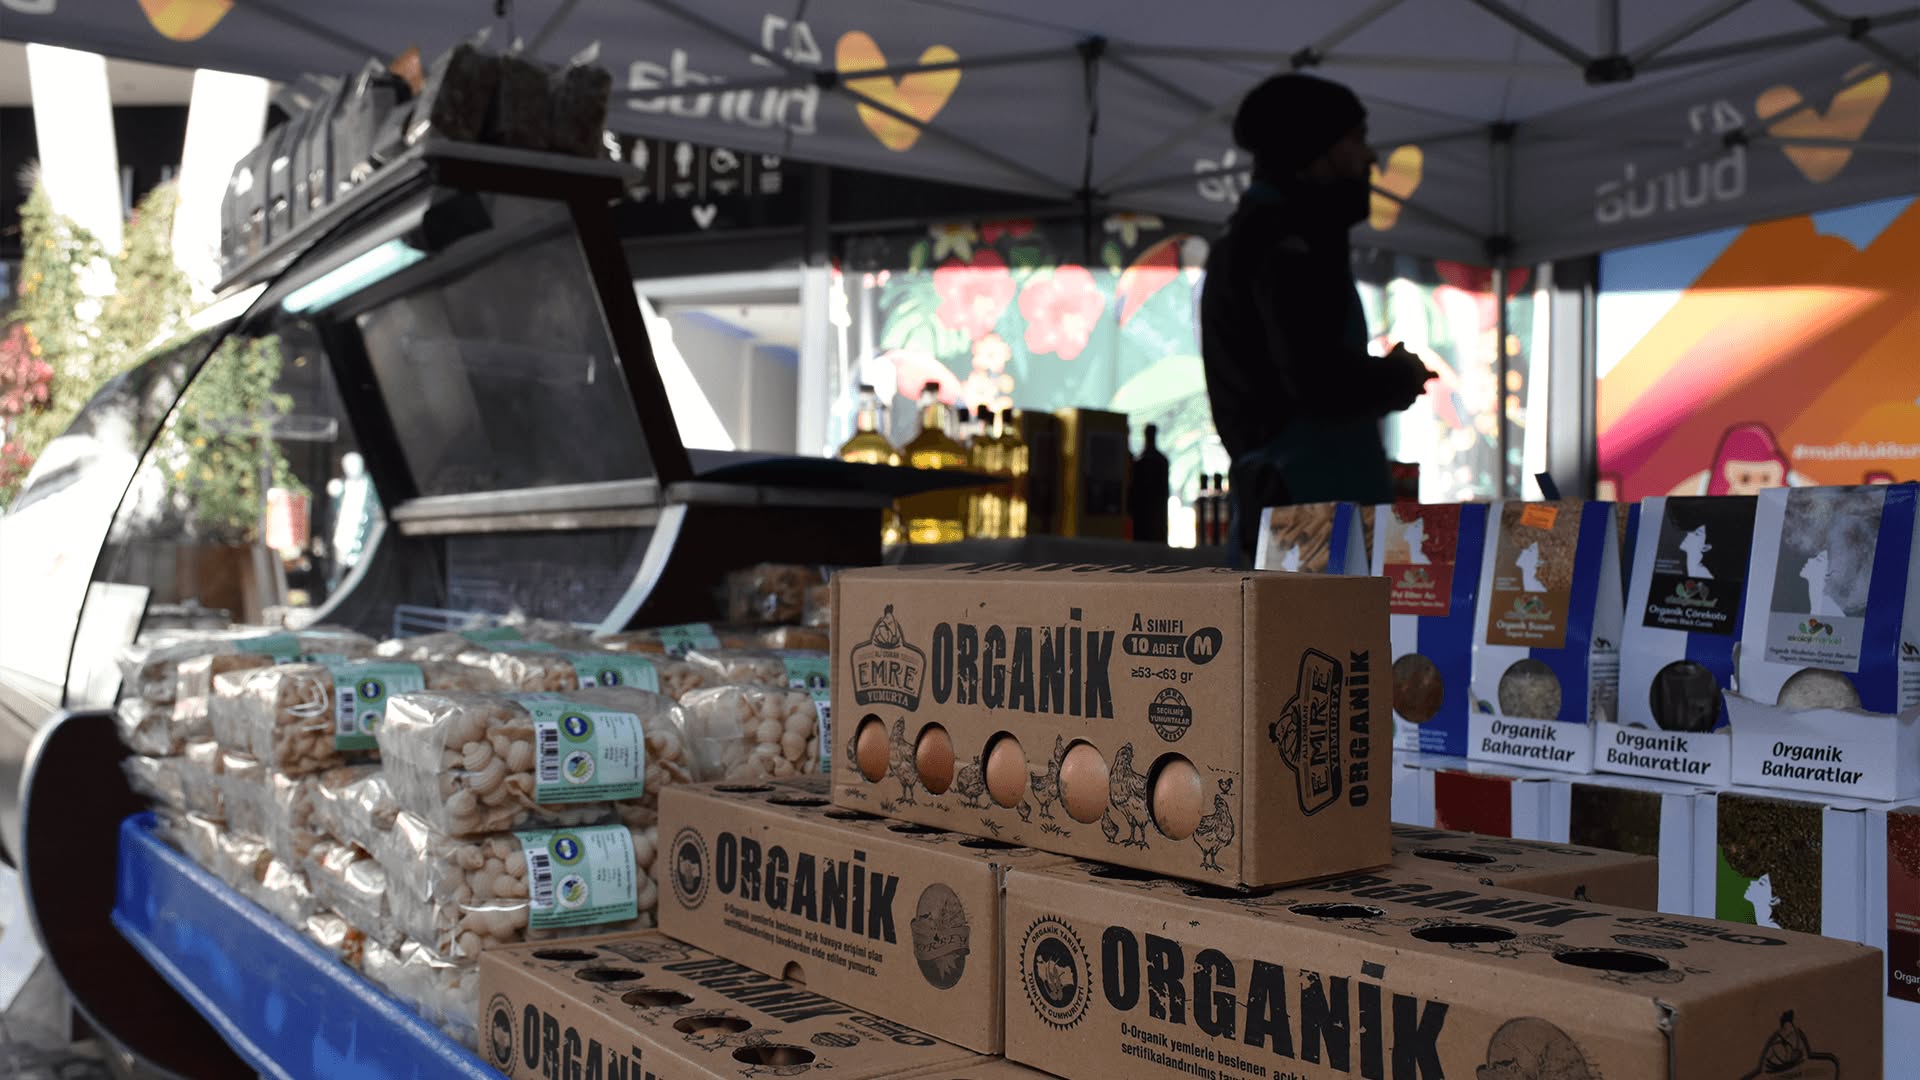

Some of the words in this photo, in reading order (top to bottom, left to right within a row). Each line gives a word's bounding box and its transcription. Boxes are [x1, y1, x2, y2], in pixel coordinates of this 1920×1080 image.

[1132, 613, 1143, 632] A
[1147, 619, 1184, 633] SINIFI
[1131, 637, 1149, 654] 10
[1152, 642, 1180, 656] ADET
[1194, 635, 1213, 656] M
[858, 660, 918, 694] EMRE
[932, 607, 1115, 719] ORGANİK
[1181, 671, 1193, 684] gr
[867, 690, 909, 707] YUMURTA
[1310, 664, 1332, 796] EMRE
[1330, 680, 1341, 770] YUMURTA
[1346, 650, 1370, 808] ORGANİK
[1491, 720, 1556, 742] Organik
[1481, 738, 1575, 763] Baharatlar
[1616, 730, 1688, 753] Organik
[1772, 741, 1843, 763] Organik
[1606, 747, 1711, 776] Baharatlar
[1761, 760, 1863, 786] Baharatlar
[716, 831, 899, 944] ORGANİK
[1308, 874, 1612, 927] RGANİK
[1032, 925, 1059, 944] ORGANİK
[1060, 930, 1079, 955] TARIM
[1102, 925, 1449, 1080] ORGANİK
[523, 1004, 668, 1080] ORGAN
[1121, 1022, 1168, 1047] O-Organik
[1170, 1038, 1215, 1062] yemlerle
[1217, 1050, 1267, 1078] beslenen
